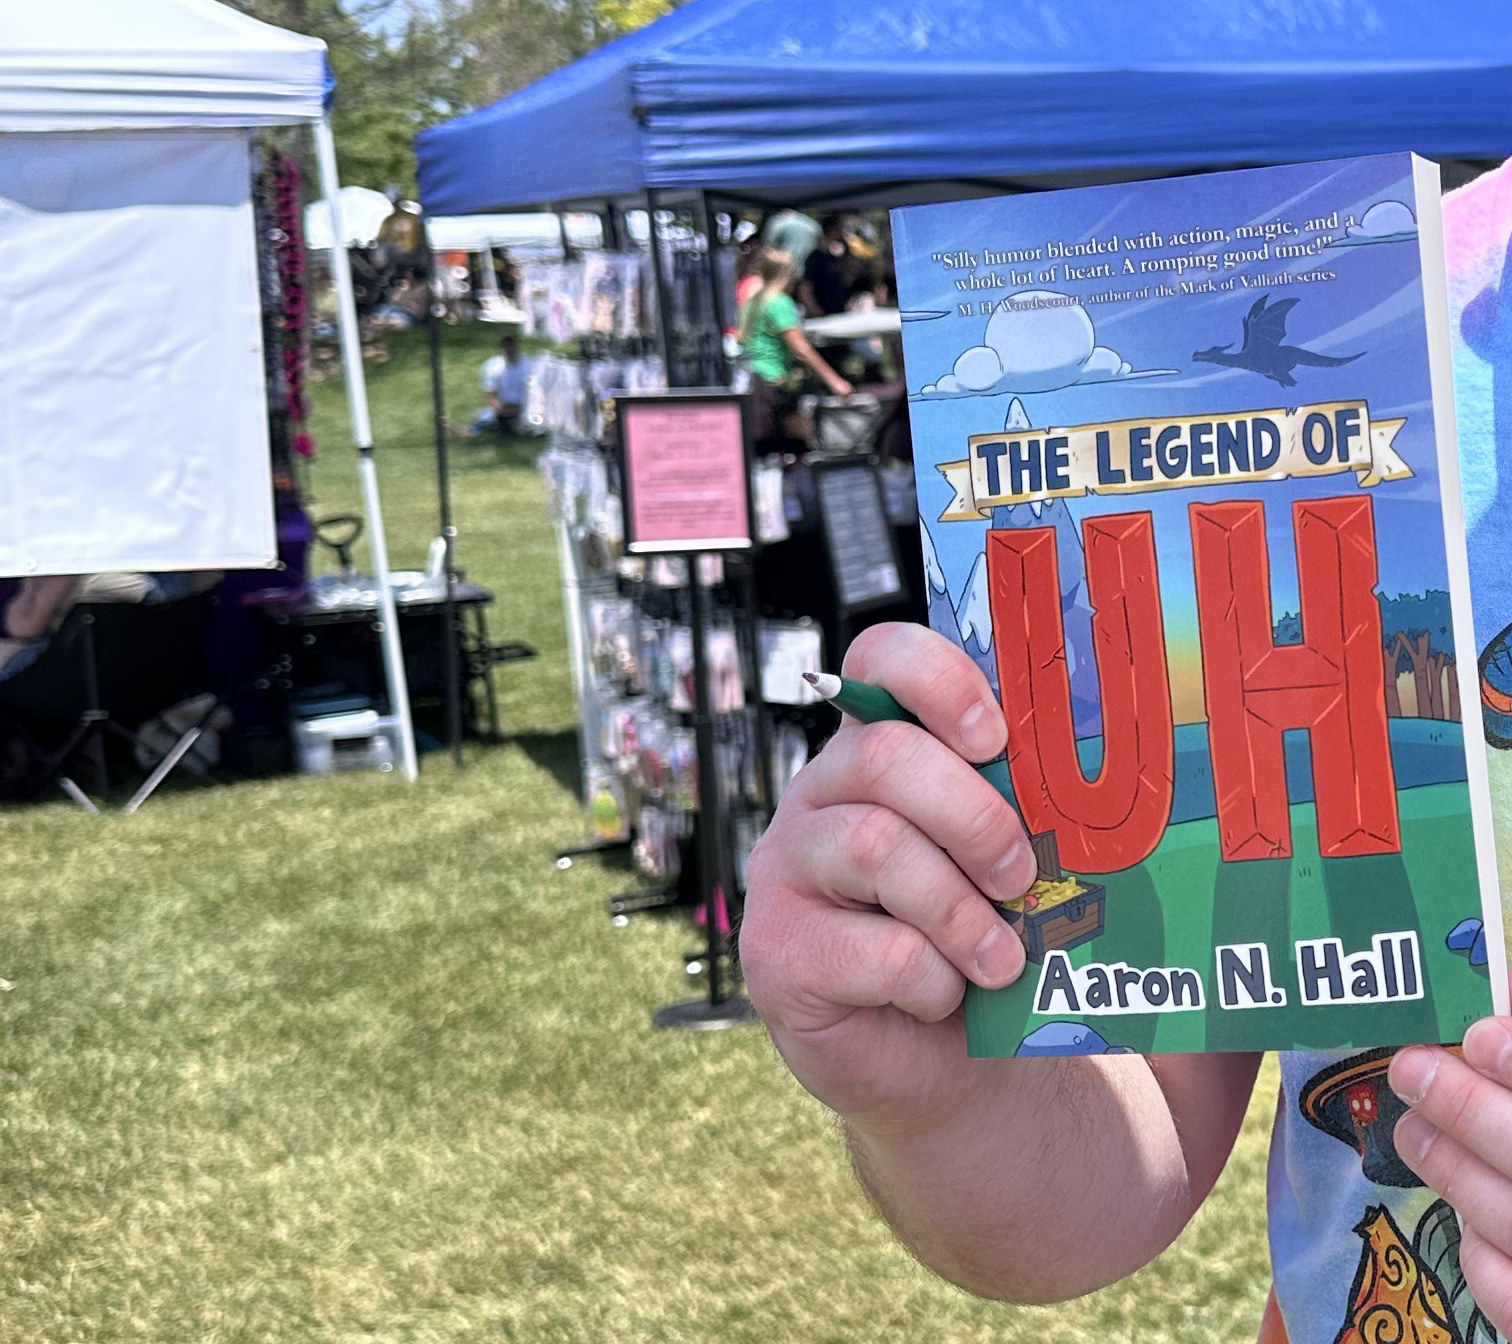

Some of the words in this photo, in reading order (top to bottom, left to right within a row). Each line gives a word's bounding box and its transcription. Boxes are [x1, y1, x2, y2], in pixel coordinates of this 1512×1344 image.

[932, 250, 978, 272] "Silly
[984, 248, 1043, 266] humor
[1047, 235, 1119, 258] blended
[1124, 231, 1164, 251] with
[1169, 225, 1231, 246] action,
[1235, 217, 1299, 241] magic,
[1303, 211, 1339, 232] and
[1344, 215, 1355, 227] a
[955, 274, 1006, 292] whole
[1010, 269, 1034, 286] lot
[1039, 264, 1056, 283] of
[1064, 262, 1116, 281] heart.
[1121, 257, 1135, 275] A
[1141, 250, 1219, 274] romping
[1223, 243, 1270, 269] good
[1275, 235, 1333, 259] time!"
[1088, 289, 1132, 305] author
[1135, 285, 1150, 300] of
[1155, 282, 1176, 297] the
[1180, 279, 1217, 295] Mark
[1221, 277, 1235, 292] of
[1240, 271, 1293, 288] Valliath
[1297, 267, 1336, 282] series
[976, 436, 1070, 497] THE
[1095, 417, 1281, 485] LEGEND
[1302, 408, 1361, 465] OF
[986, 494, 1402, 874] UH
[1037, 953, 1202, 1012] Aaron
[1219, 946, 1284, 1006] N.
[1299, 937, 1419, 1001] Hall
